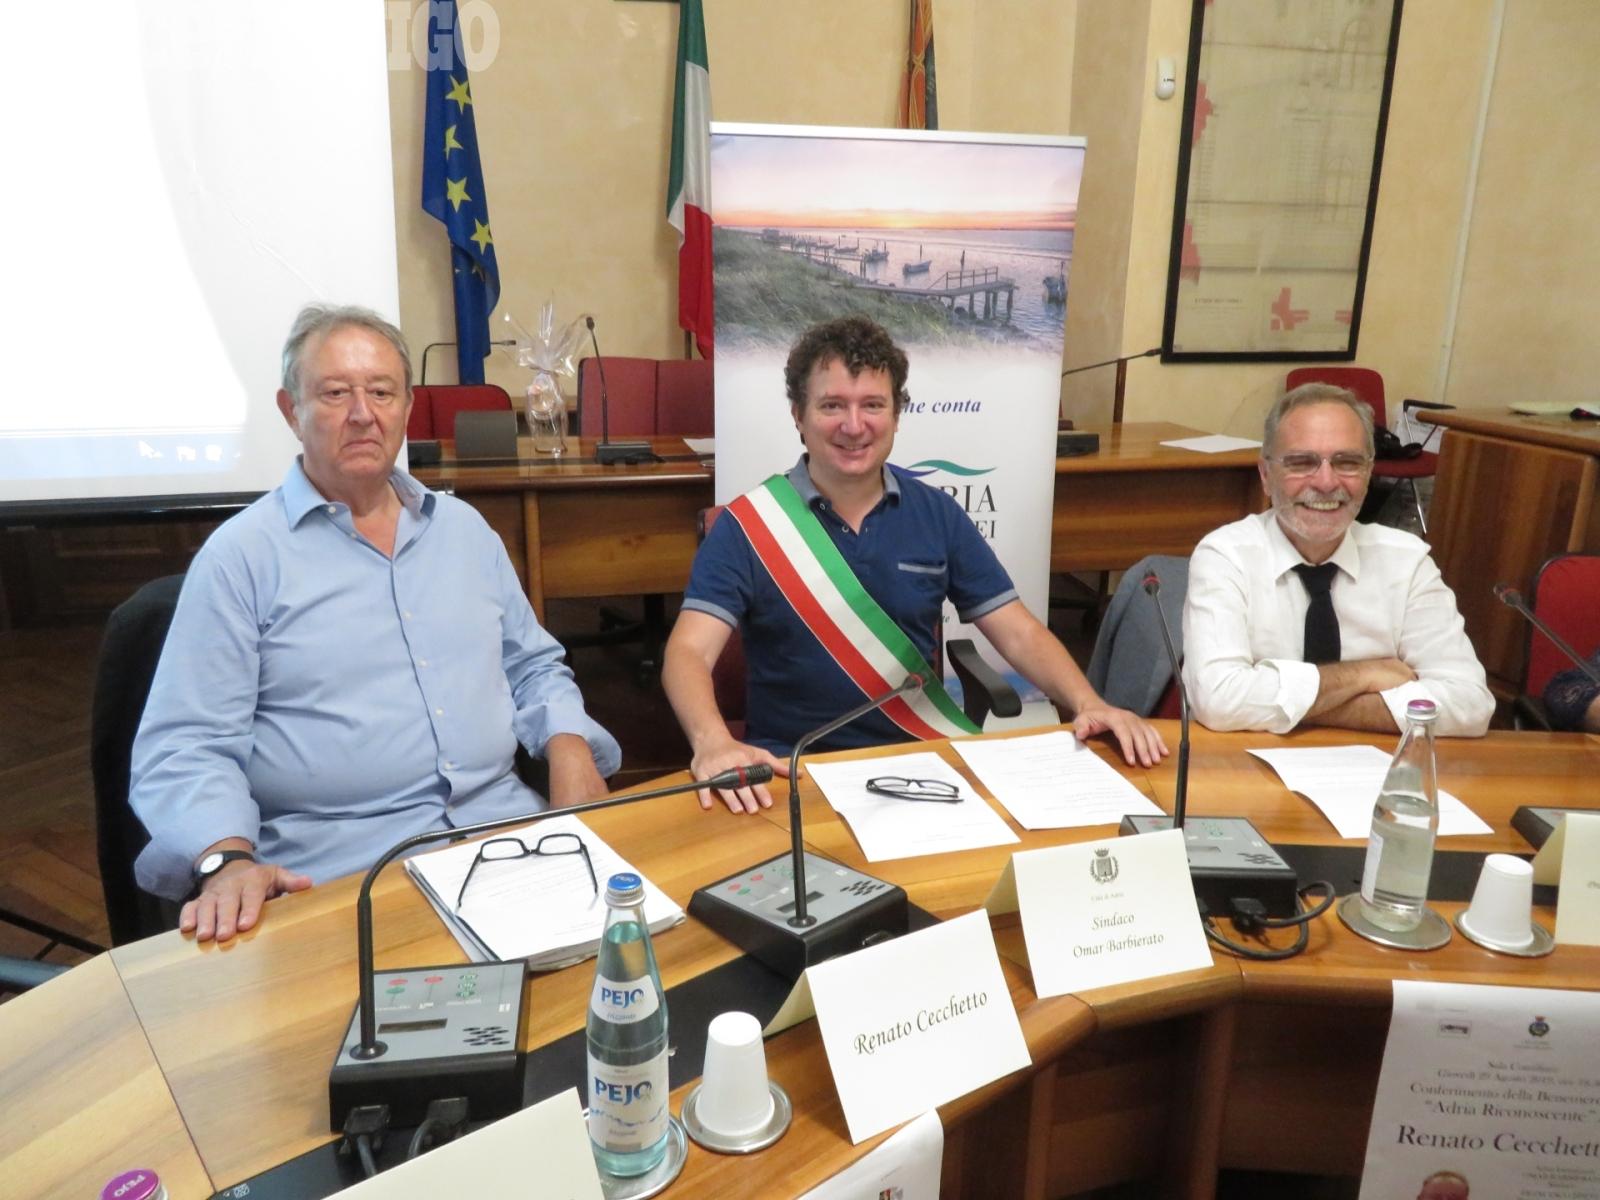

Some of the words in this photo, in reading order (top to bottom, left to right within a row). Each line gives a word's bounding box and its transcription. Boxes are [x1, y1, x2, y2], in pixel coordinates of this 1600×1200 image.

[932, 399, 981, 413] conta
[1091, 911, 1135, 930] Sindaco
[1073, 944, 1104, 958] Omar
[1106, 933, 1164, 952] Barbierato
[601, 986, 645, 1009] PEJO
[853, 1021, 912, 1055] Renato
[916, 991, 988, 1032] Cecchetto
[594, 1076, 653, 1106] PEJO
[1410, 1082, 1500, 1099] Conferimento
[1501, 1086, 1533, 1101] della
[1396, 1123, 1485, 1151] Renato
